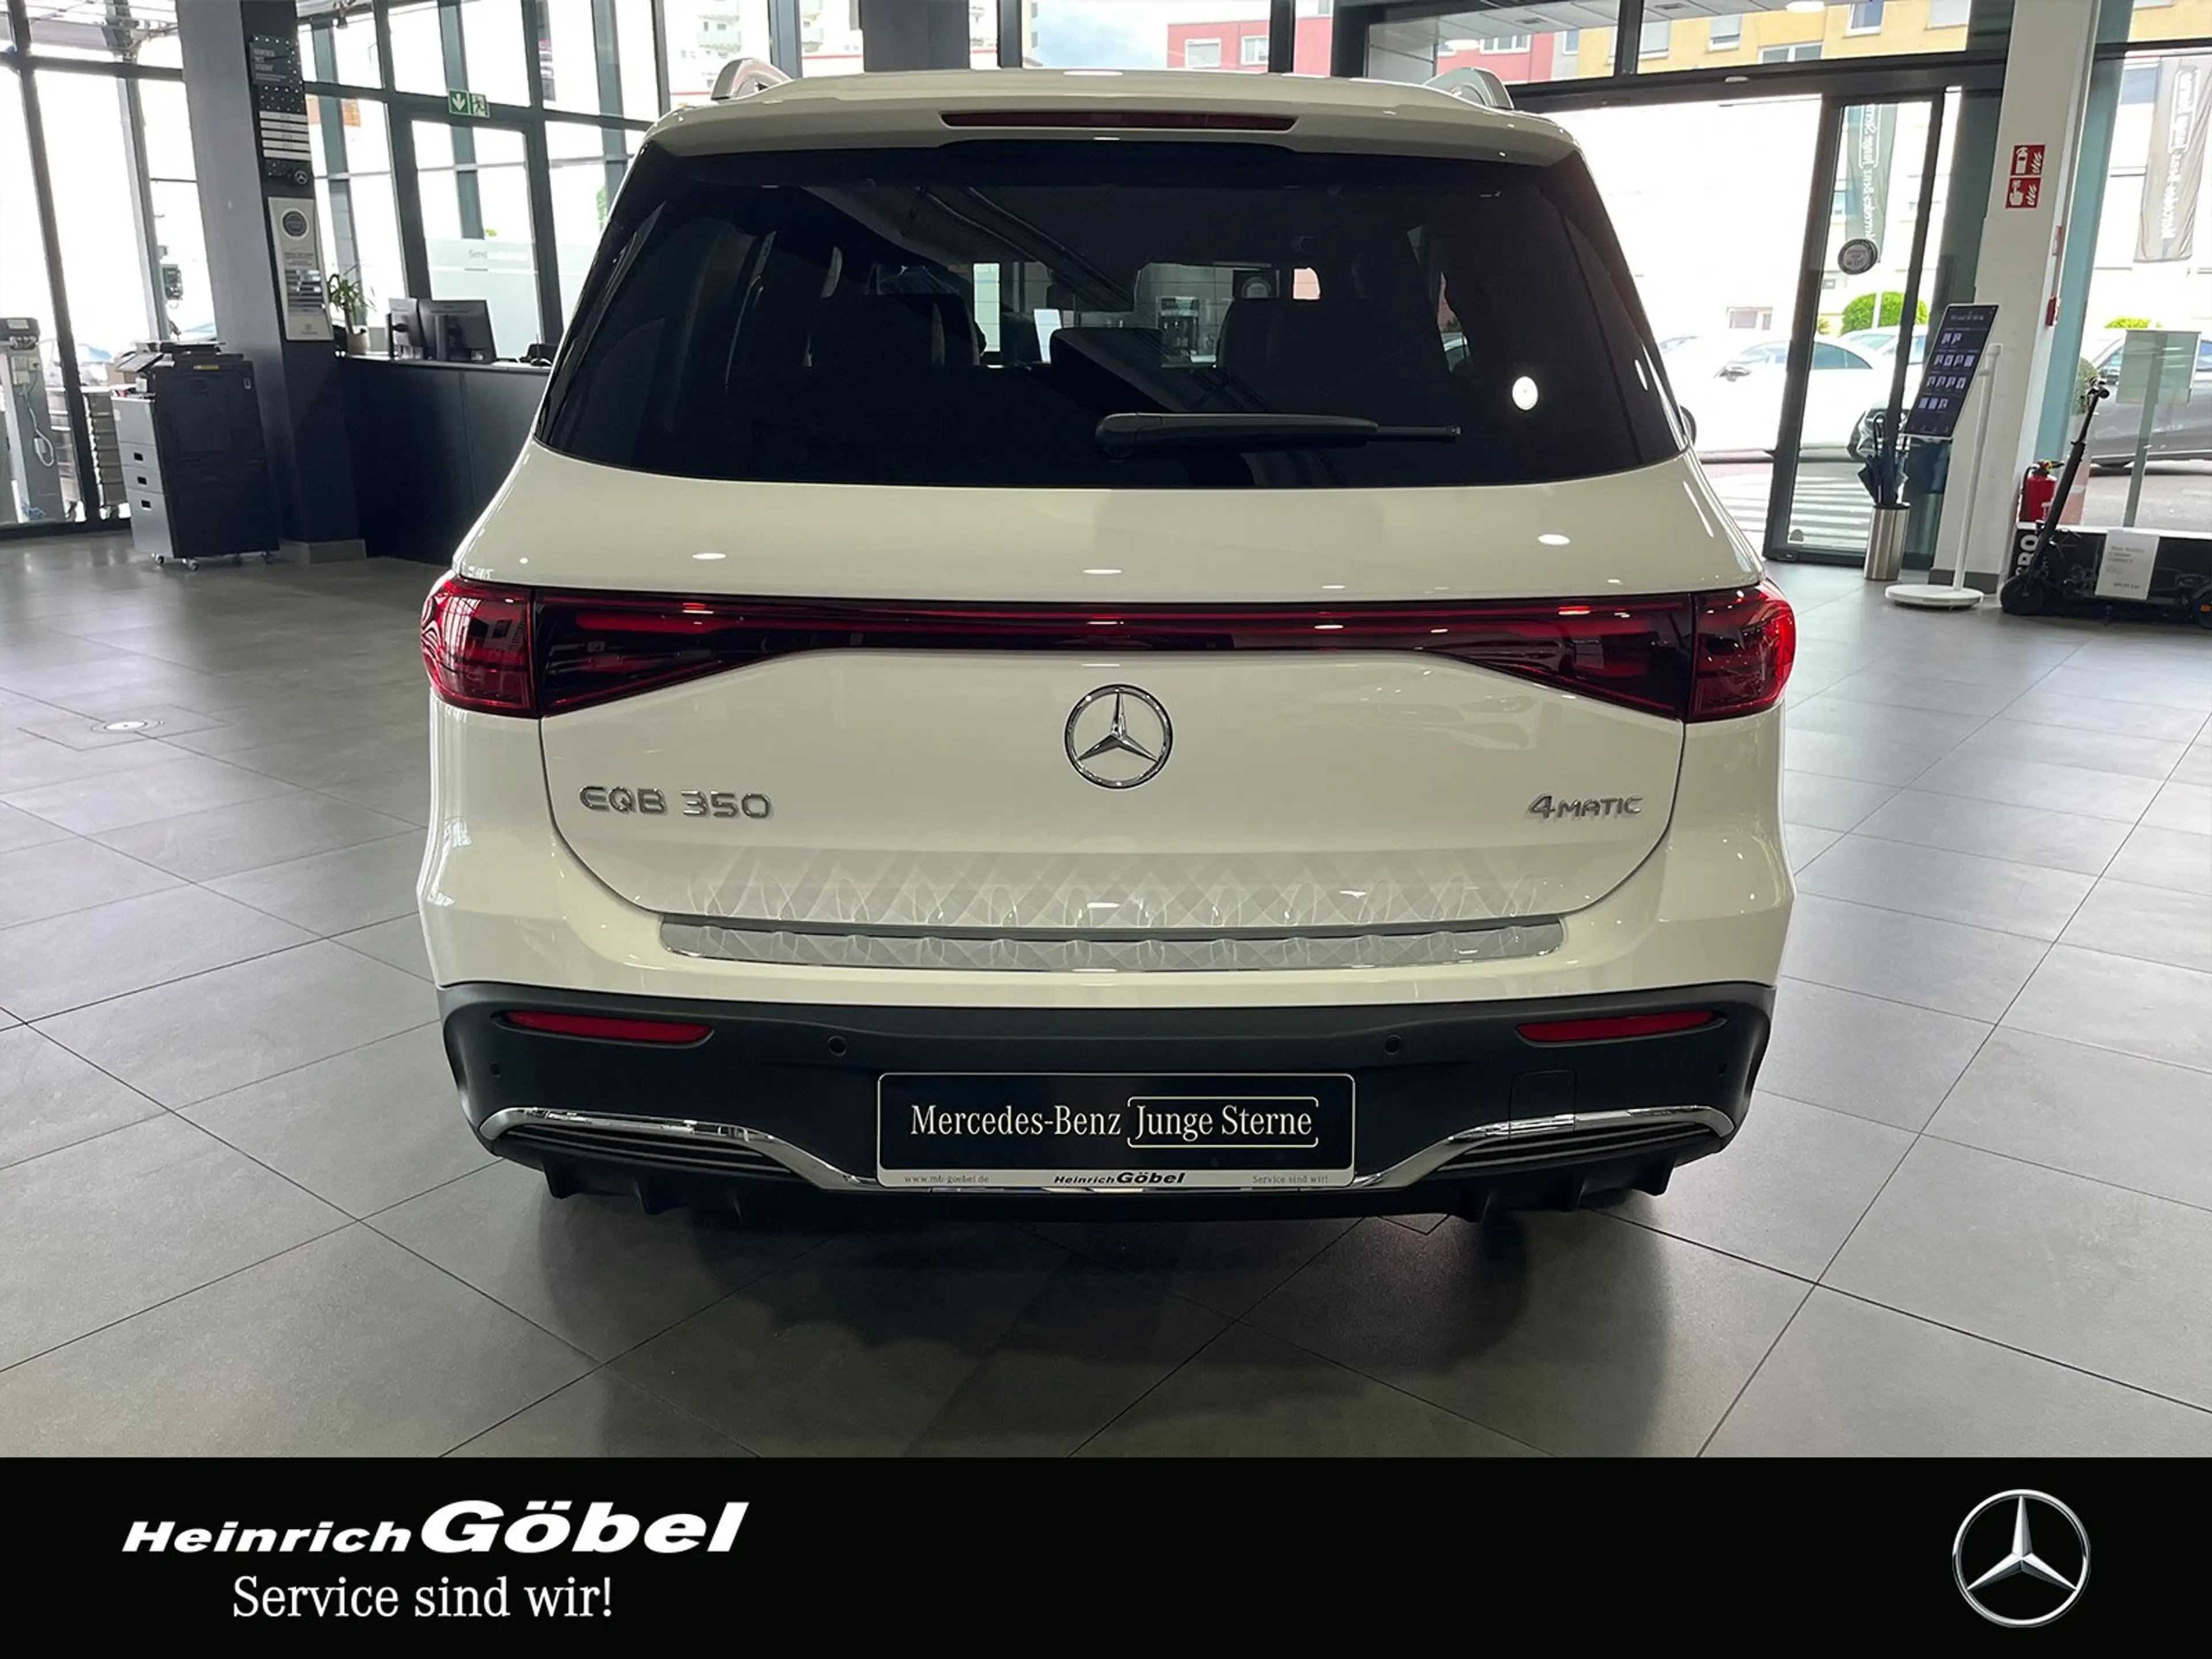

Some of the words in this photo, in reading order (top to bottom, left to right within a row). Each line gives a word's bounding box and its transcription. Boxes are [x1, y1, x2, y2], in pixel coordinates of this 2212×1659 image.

[579, 786, 668, 813] EQB
[680, 790, 772, 819] 350
[911, 1105, 1121, 1135] Mercedes-Benz
[1134, 1105, 1213, 1142] Junge
[1222, 1104, 1312, 1135] Sterne
[1054, 1175, 1115, 1184] Heinrich
[1116, 1172, 1185, 1184] Göbel
[1253, 1175, 1286, 1183] Service
[1288, 1175, 1308, 1183] sind
